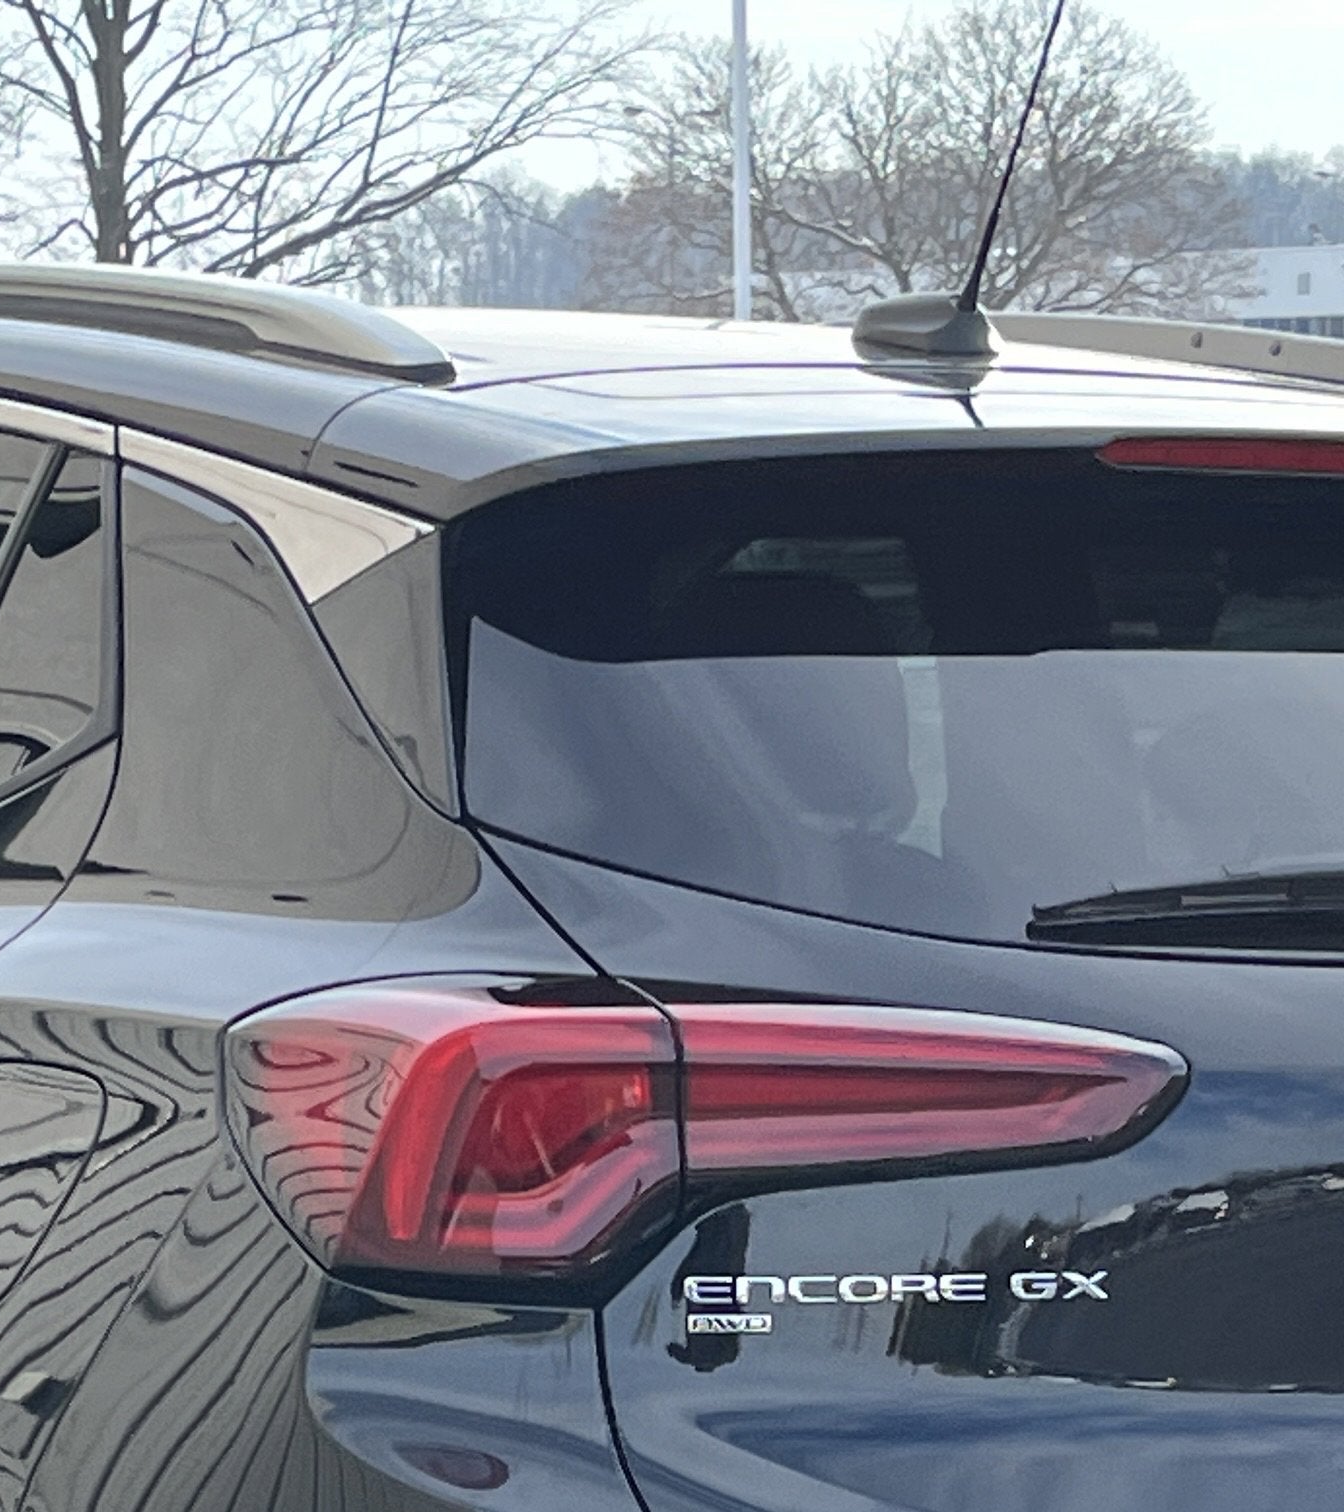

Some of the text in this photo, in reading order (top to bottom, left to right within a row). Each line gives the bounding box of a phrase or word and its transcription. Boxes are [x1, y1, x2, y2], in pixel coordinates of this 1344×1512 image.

[682, 1270, 1109, 1304] ENCORE GX
[690, 1315, 770, 1332] AWD
